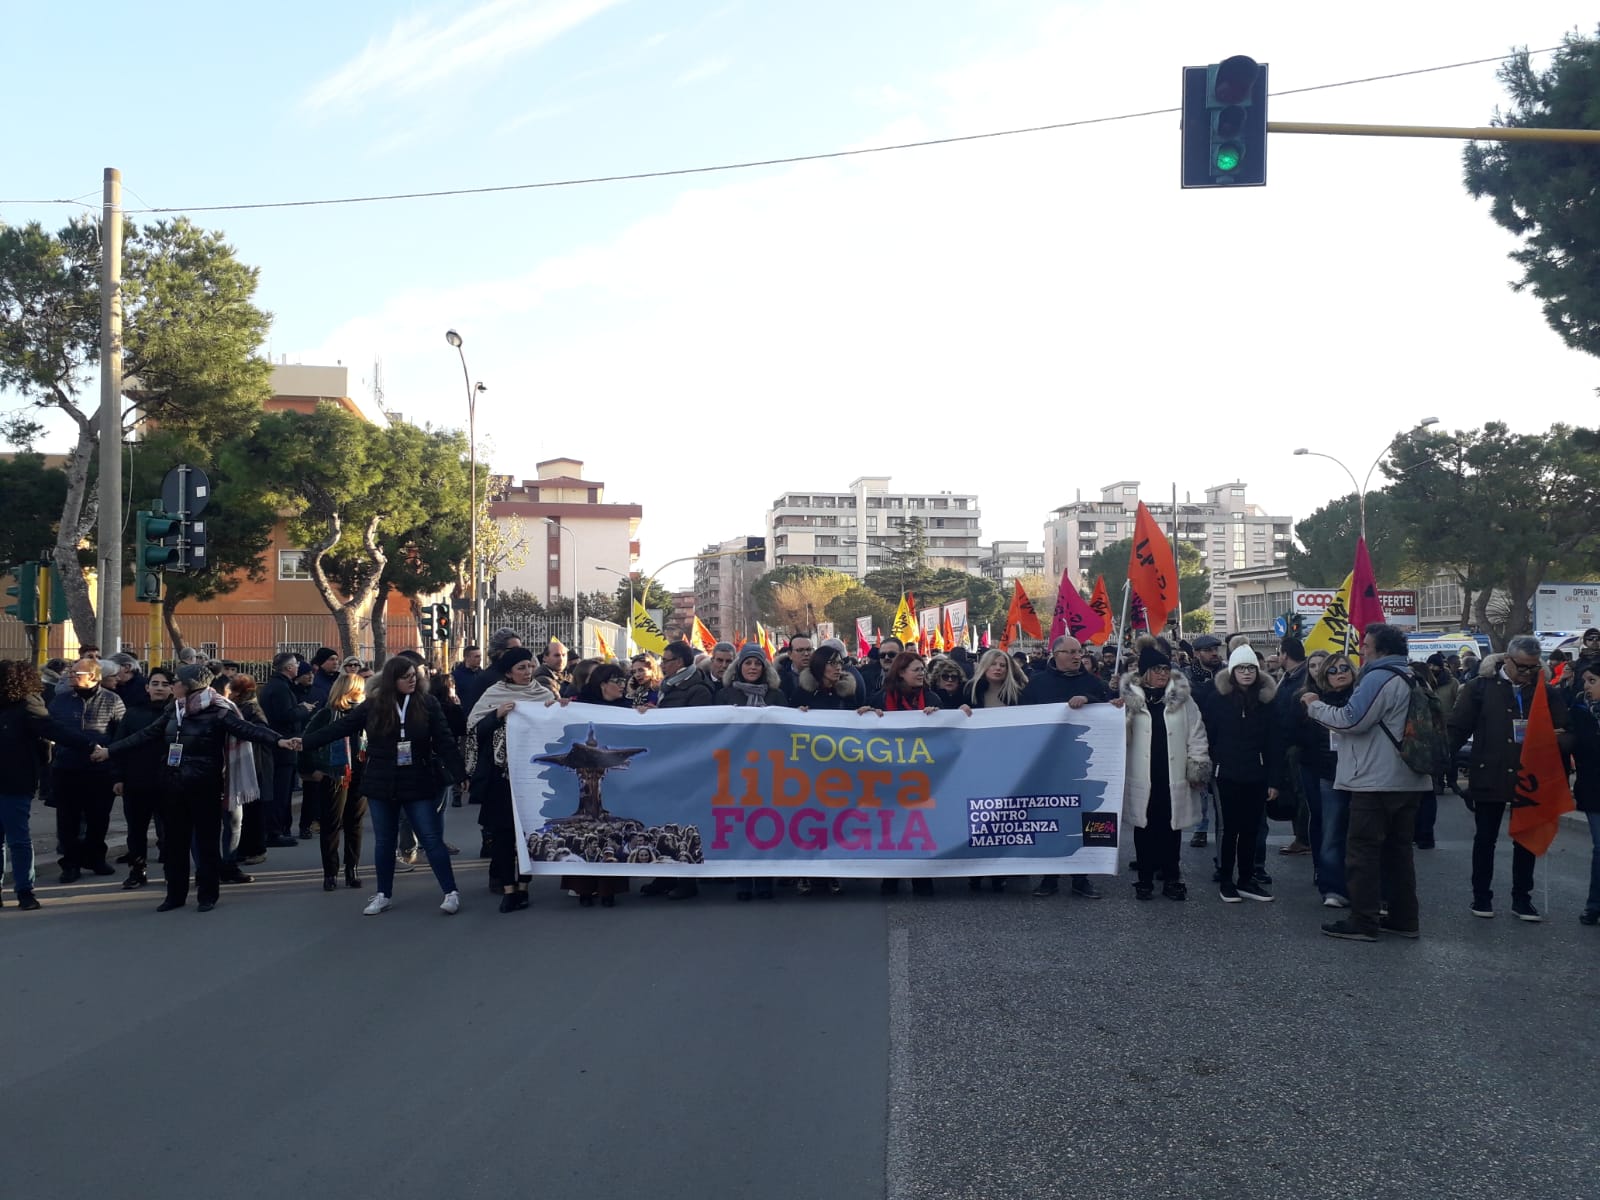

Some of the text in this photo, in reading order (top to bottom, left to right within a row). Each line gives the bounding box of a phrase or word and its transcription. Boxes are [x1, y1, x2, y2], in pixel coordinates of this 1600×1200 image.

[790, 733, 935, 763] FOGGIA
[711, 749, 936, 808] libera
[970, 796, 1079, 810] MOBILITAZIONE
[970, 810, 1027, 822] CONTRO
[711, 807, 937, 850] FOGGIA
[971, 821, 1058, 834] LA VIOLENZA
[971, 834, 1033, 846] MAFIOSA
